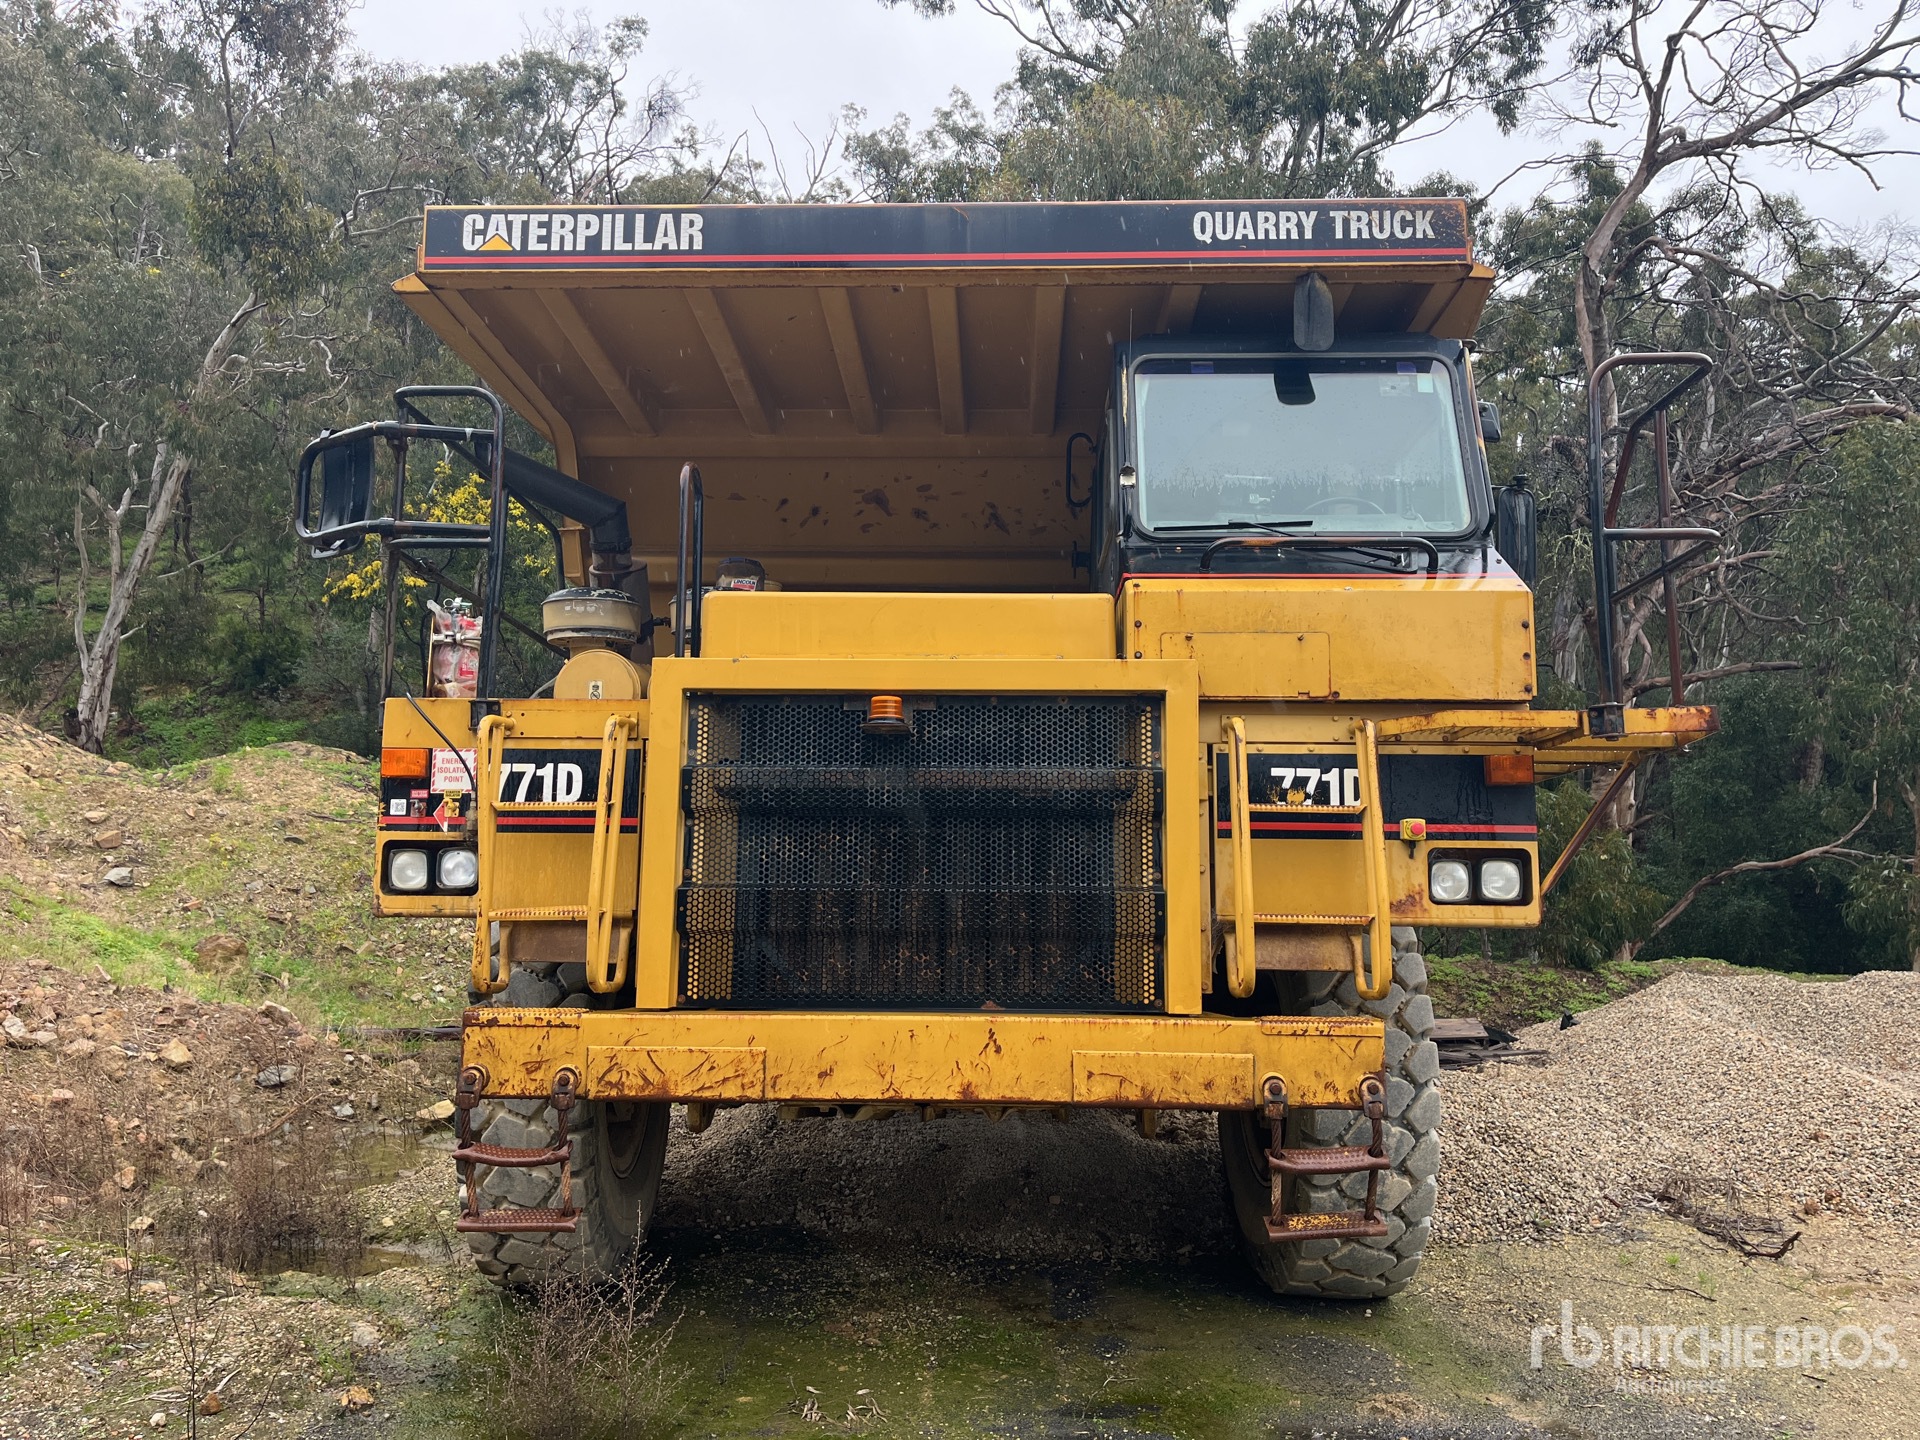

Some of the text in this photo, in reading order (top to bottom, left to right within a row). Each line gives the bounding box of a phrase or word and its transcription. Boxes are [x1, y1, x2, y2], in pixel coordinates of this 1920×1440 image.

[462, 213, 704, 251] CATERPILLAR
[1193, 209, 1435, 244] QUARRY TRUCK
[437, 766, 471, 774] ISOLATIO
[444, 775, 464, 783] POINT
[1270, 767, 1361, 806] 771D
